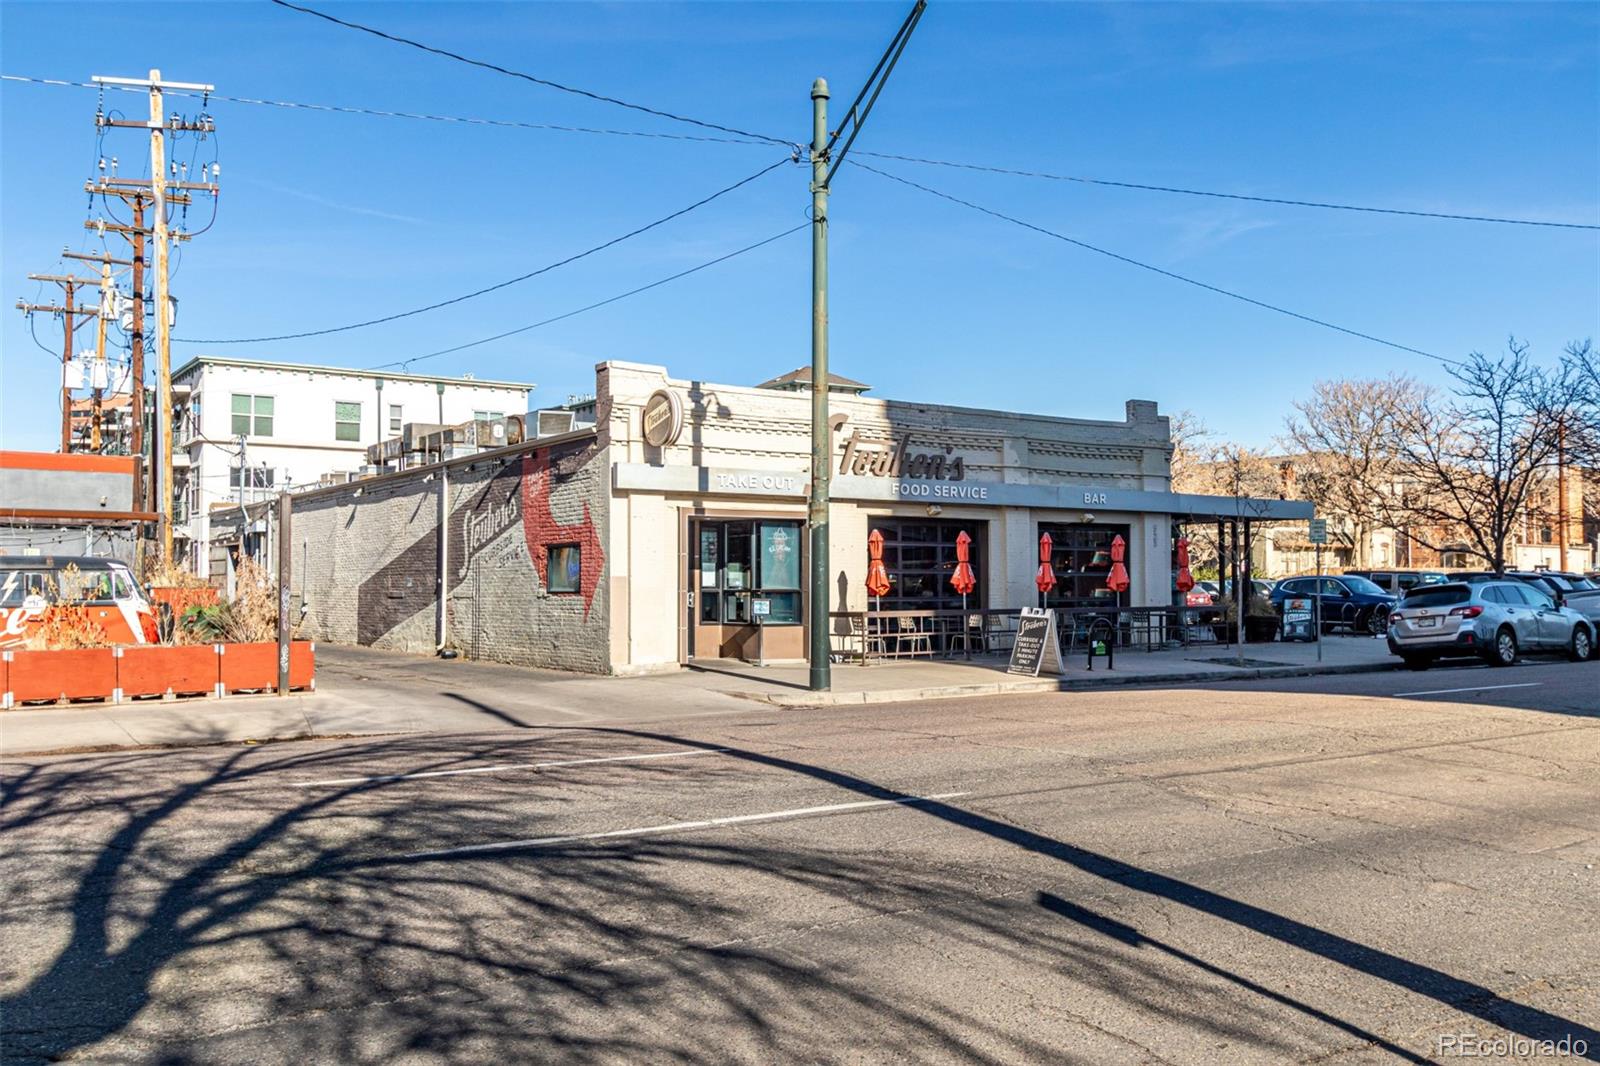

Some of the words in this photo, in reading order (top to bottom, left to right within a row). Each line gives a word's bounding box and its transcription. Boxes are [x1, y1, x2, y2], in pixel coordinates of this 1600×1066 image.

[717, 473, 758, 489] TAKE
[761, 475, 794, 491] OUT
[892, 483, 930, 497] FOOD
[934, 485, 988, 499] SERVICE
[1082, 493, 1107, 504] BAR
